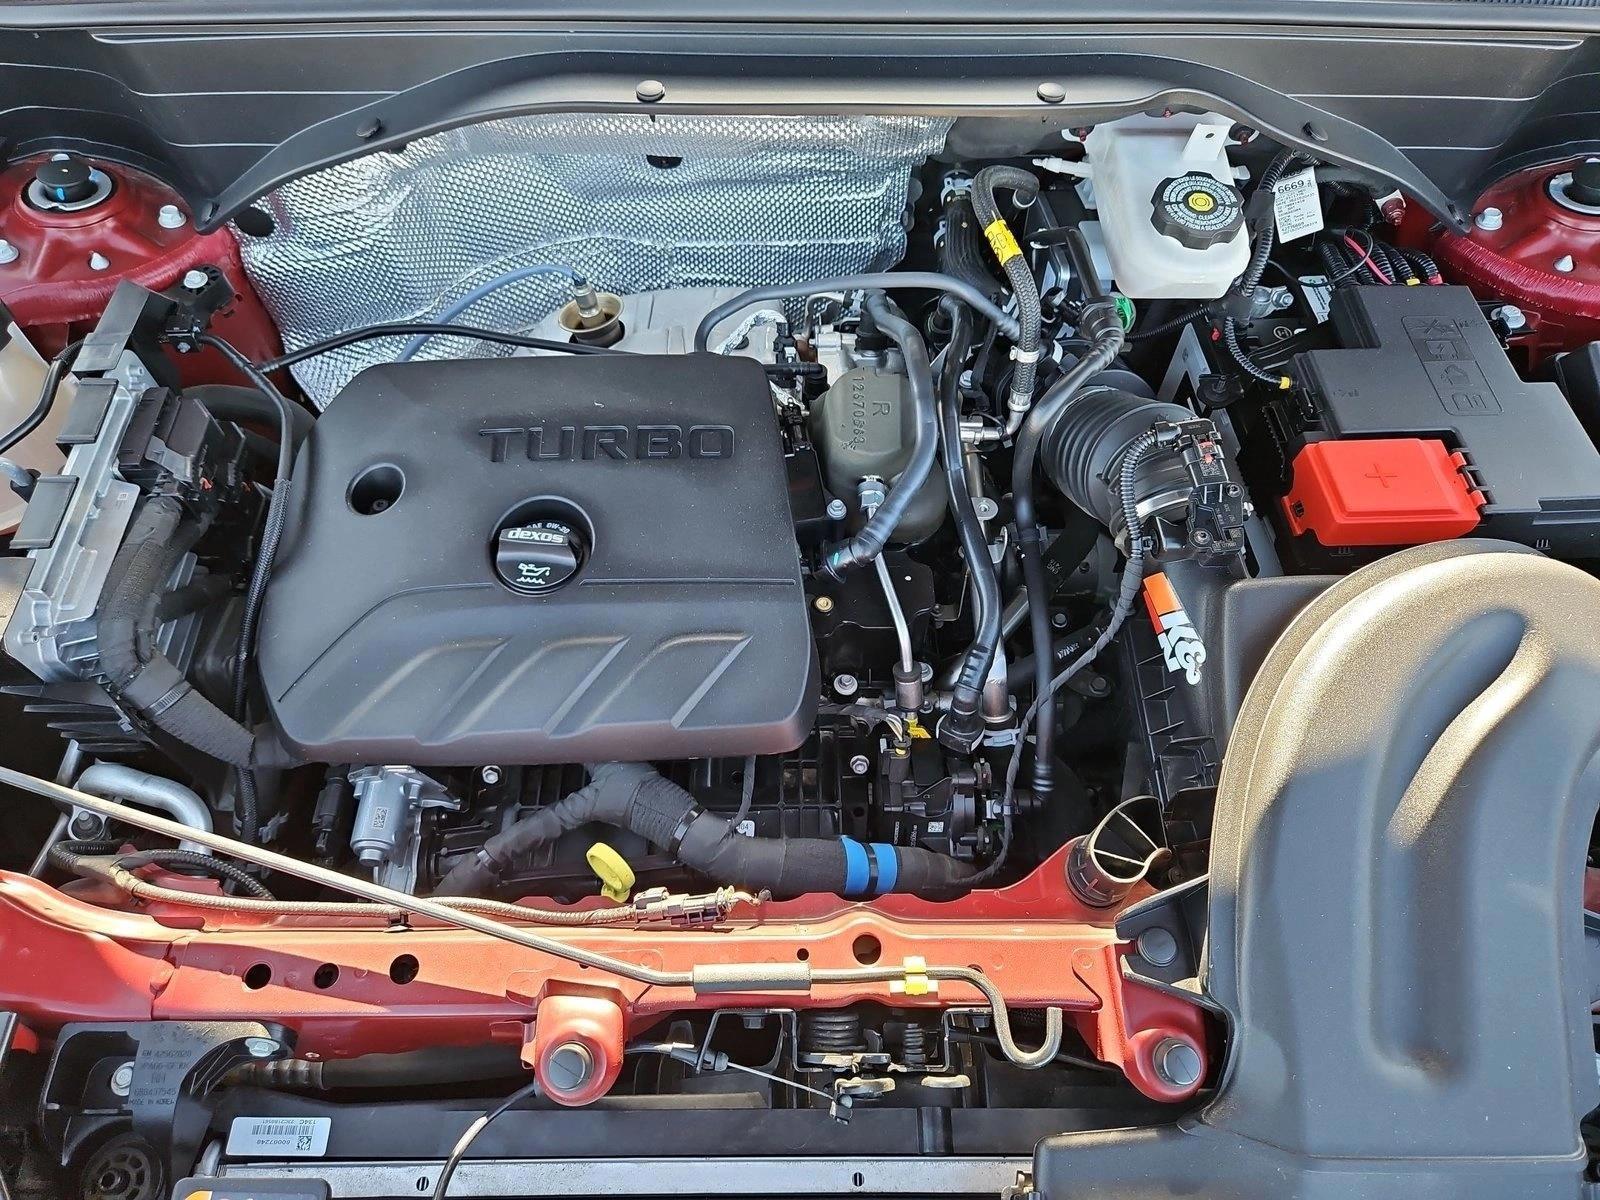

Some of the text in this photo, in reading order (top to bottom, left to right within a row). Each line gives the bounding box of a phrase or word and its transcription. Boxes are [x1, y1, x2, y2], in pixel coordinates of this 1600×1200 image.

[1277, 180, 1305, 194] 6669
[872, 402, 891, 417] R
[479, 424, 735, 463] TURBO
[507, 528, 565, 544] dexos
[1156, 609, 1207, 686] K&N
